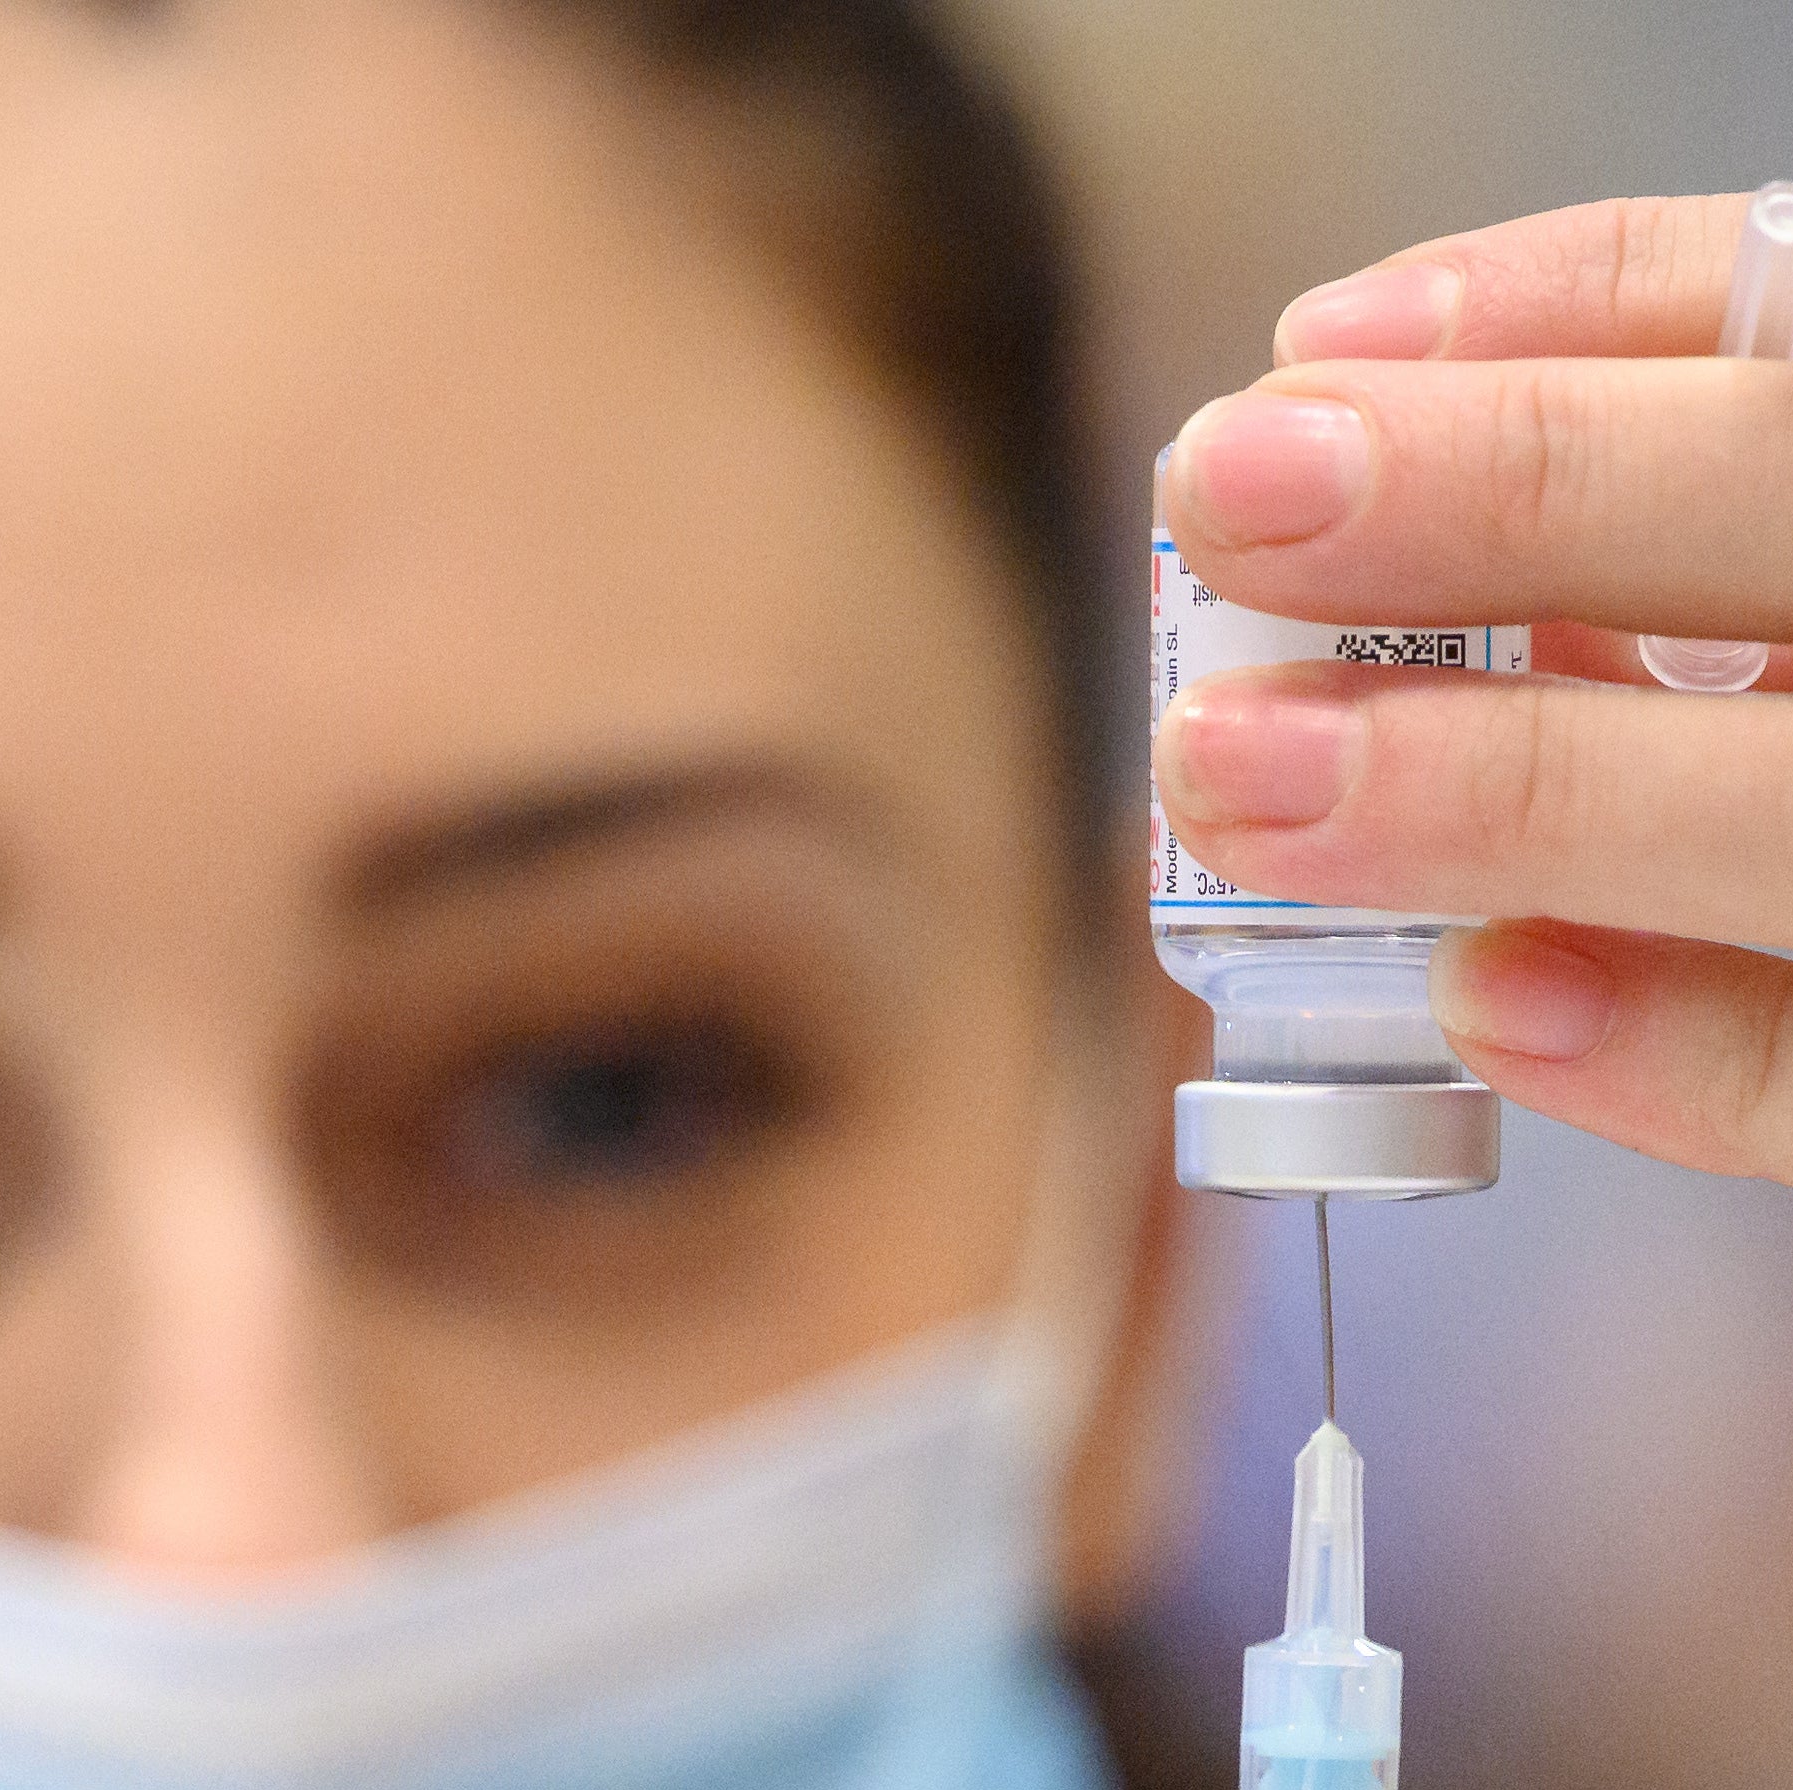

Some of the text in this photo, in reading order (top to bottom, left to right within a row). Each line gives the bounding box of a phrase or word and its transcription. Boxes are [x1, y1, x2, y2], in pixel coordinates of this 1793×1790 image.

[1166, 623, 1178, 894] Moder pain SL
